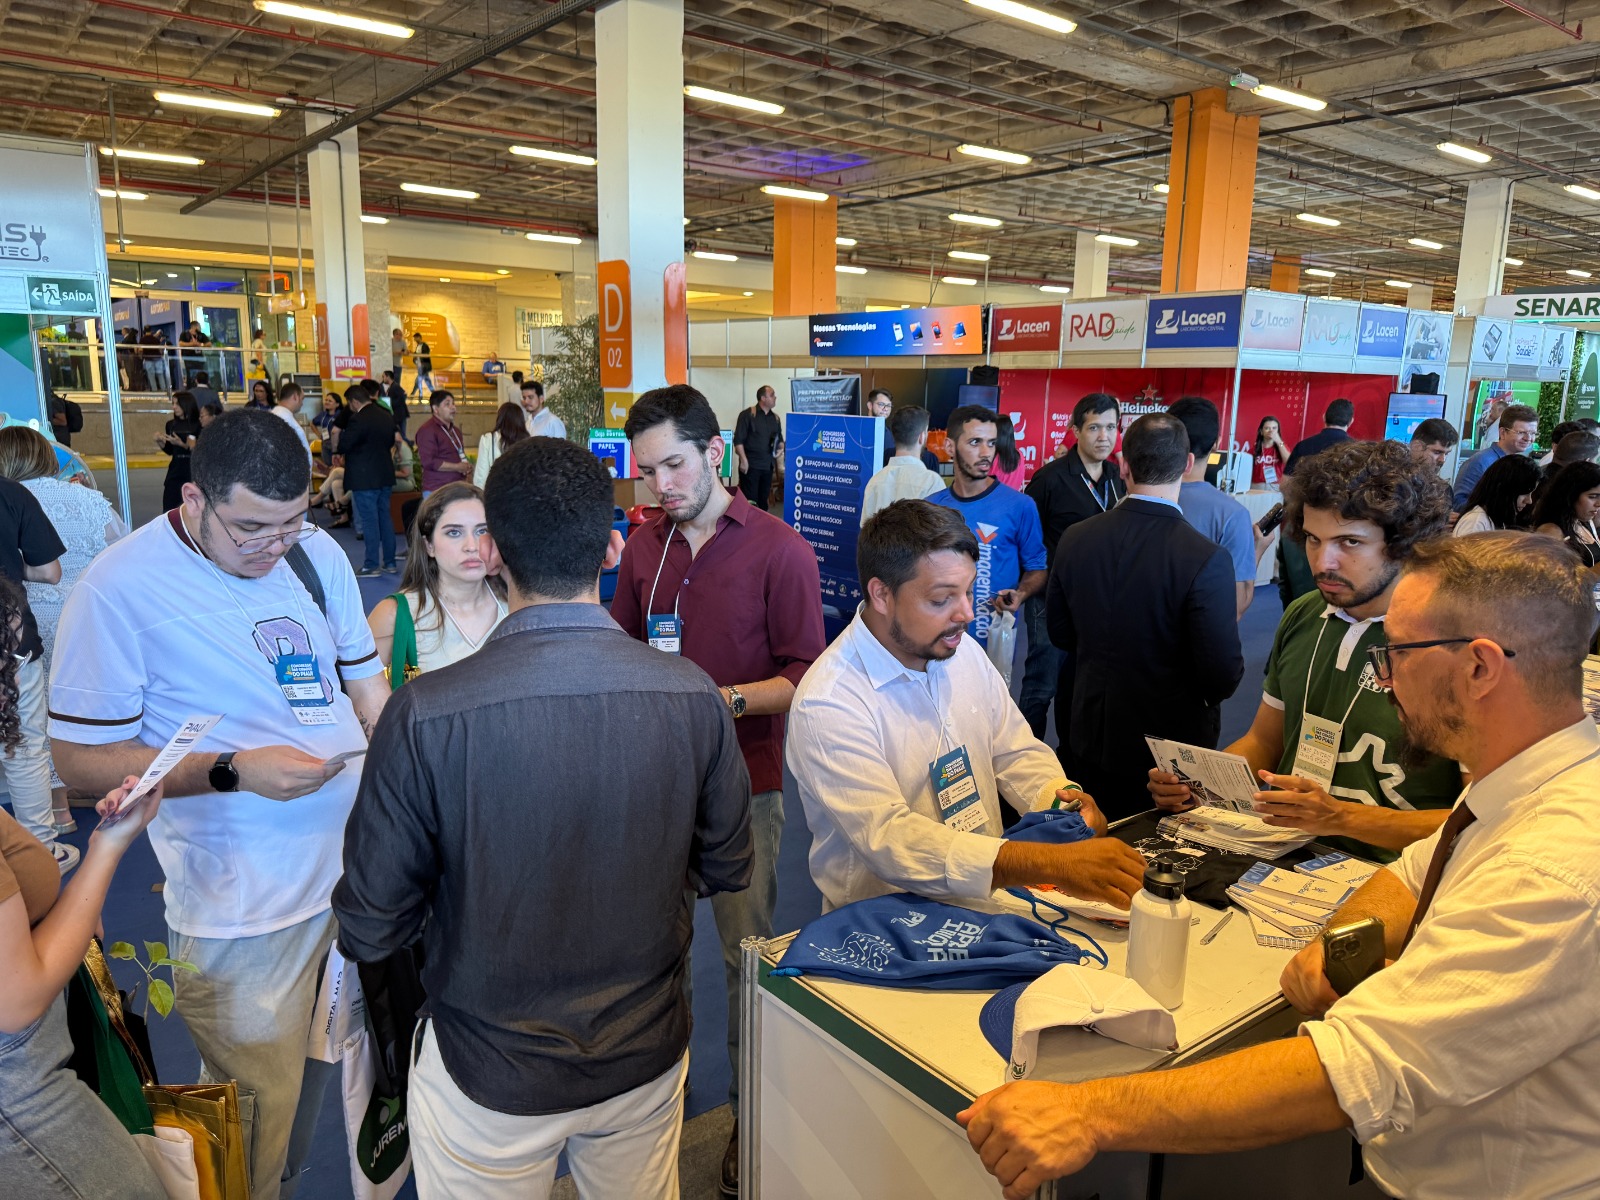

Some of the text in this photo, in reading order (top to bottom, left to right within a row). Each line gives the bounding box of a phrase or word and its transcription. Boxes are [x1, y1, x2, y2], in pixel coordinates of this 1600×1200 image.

[62, 289, 94, 302] SAÍDA
[604, 283, 623, 332] D
[1514, 297, 1600, 317] SENAR
[527, 312, 553, 325] MELHOR
[1181, 310, 1227, 326] Lacen
[1267, 311, 1294, 329] Lacen
[813, 321, 877, 333] Nossas Tecnologias
[1016, 320, 1051, 334] Lacen
[1070, 313, 1115, 342] RAD
[1375, 324, 1400, 338] Lacen
[335, 357, 367, 369] ENTRADA
[607, 347, 623, 368] 02
[1120, 402, 1171, 414] Heineke
[822, 441, 830, 449] DO
[804, 459, 822, 468] ESPAÇO
[822, 461, 833, 469] PIAUÍ
[835, 462, 859, 471] AUDITÓRIO
[818, 474, 834, 483] ESPAÇO
[834, 475, 853, 485] TÉCNICO
[803, 486, 837, 496] ESPAÇO SEBRAE
[803, 499, 819, 508] ESPAÇO
[825, 503, 841, 511] CIDADE
[802, 512, 814, 520] FEIRA
[821, 515, 842, 525] NEGÓCIOS
[802, 526, 835, 537] ESPAÇO SEBRAE
[830, 544, 840, 552] FIAT
[325, 1000, 338, 1035] DIGITAL
